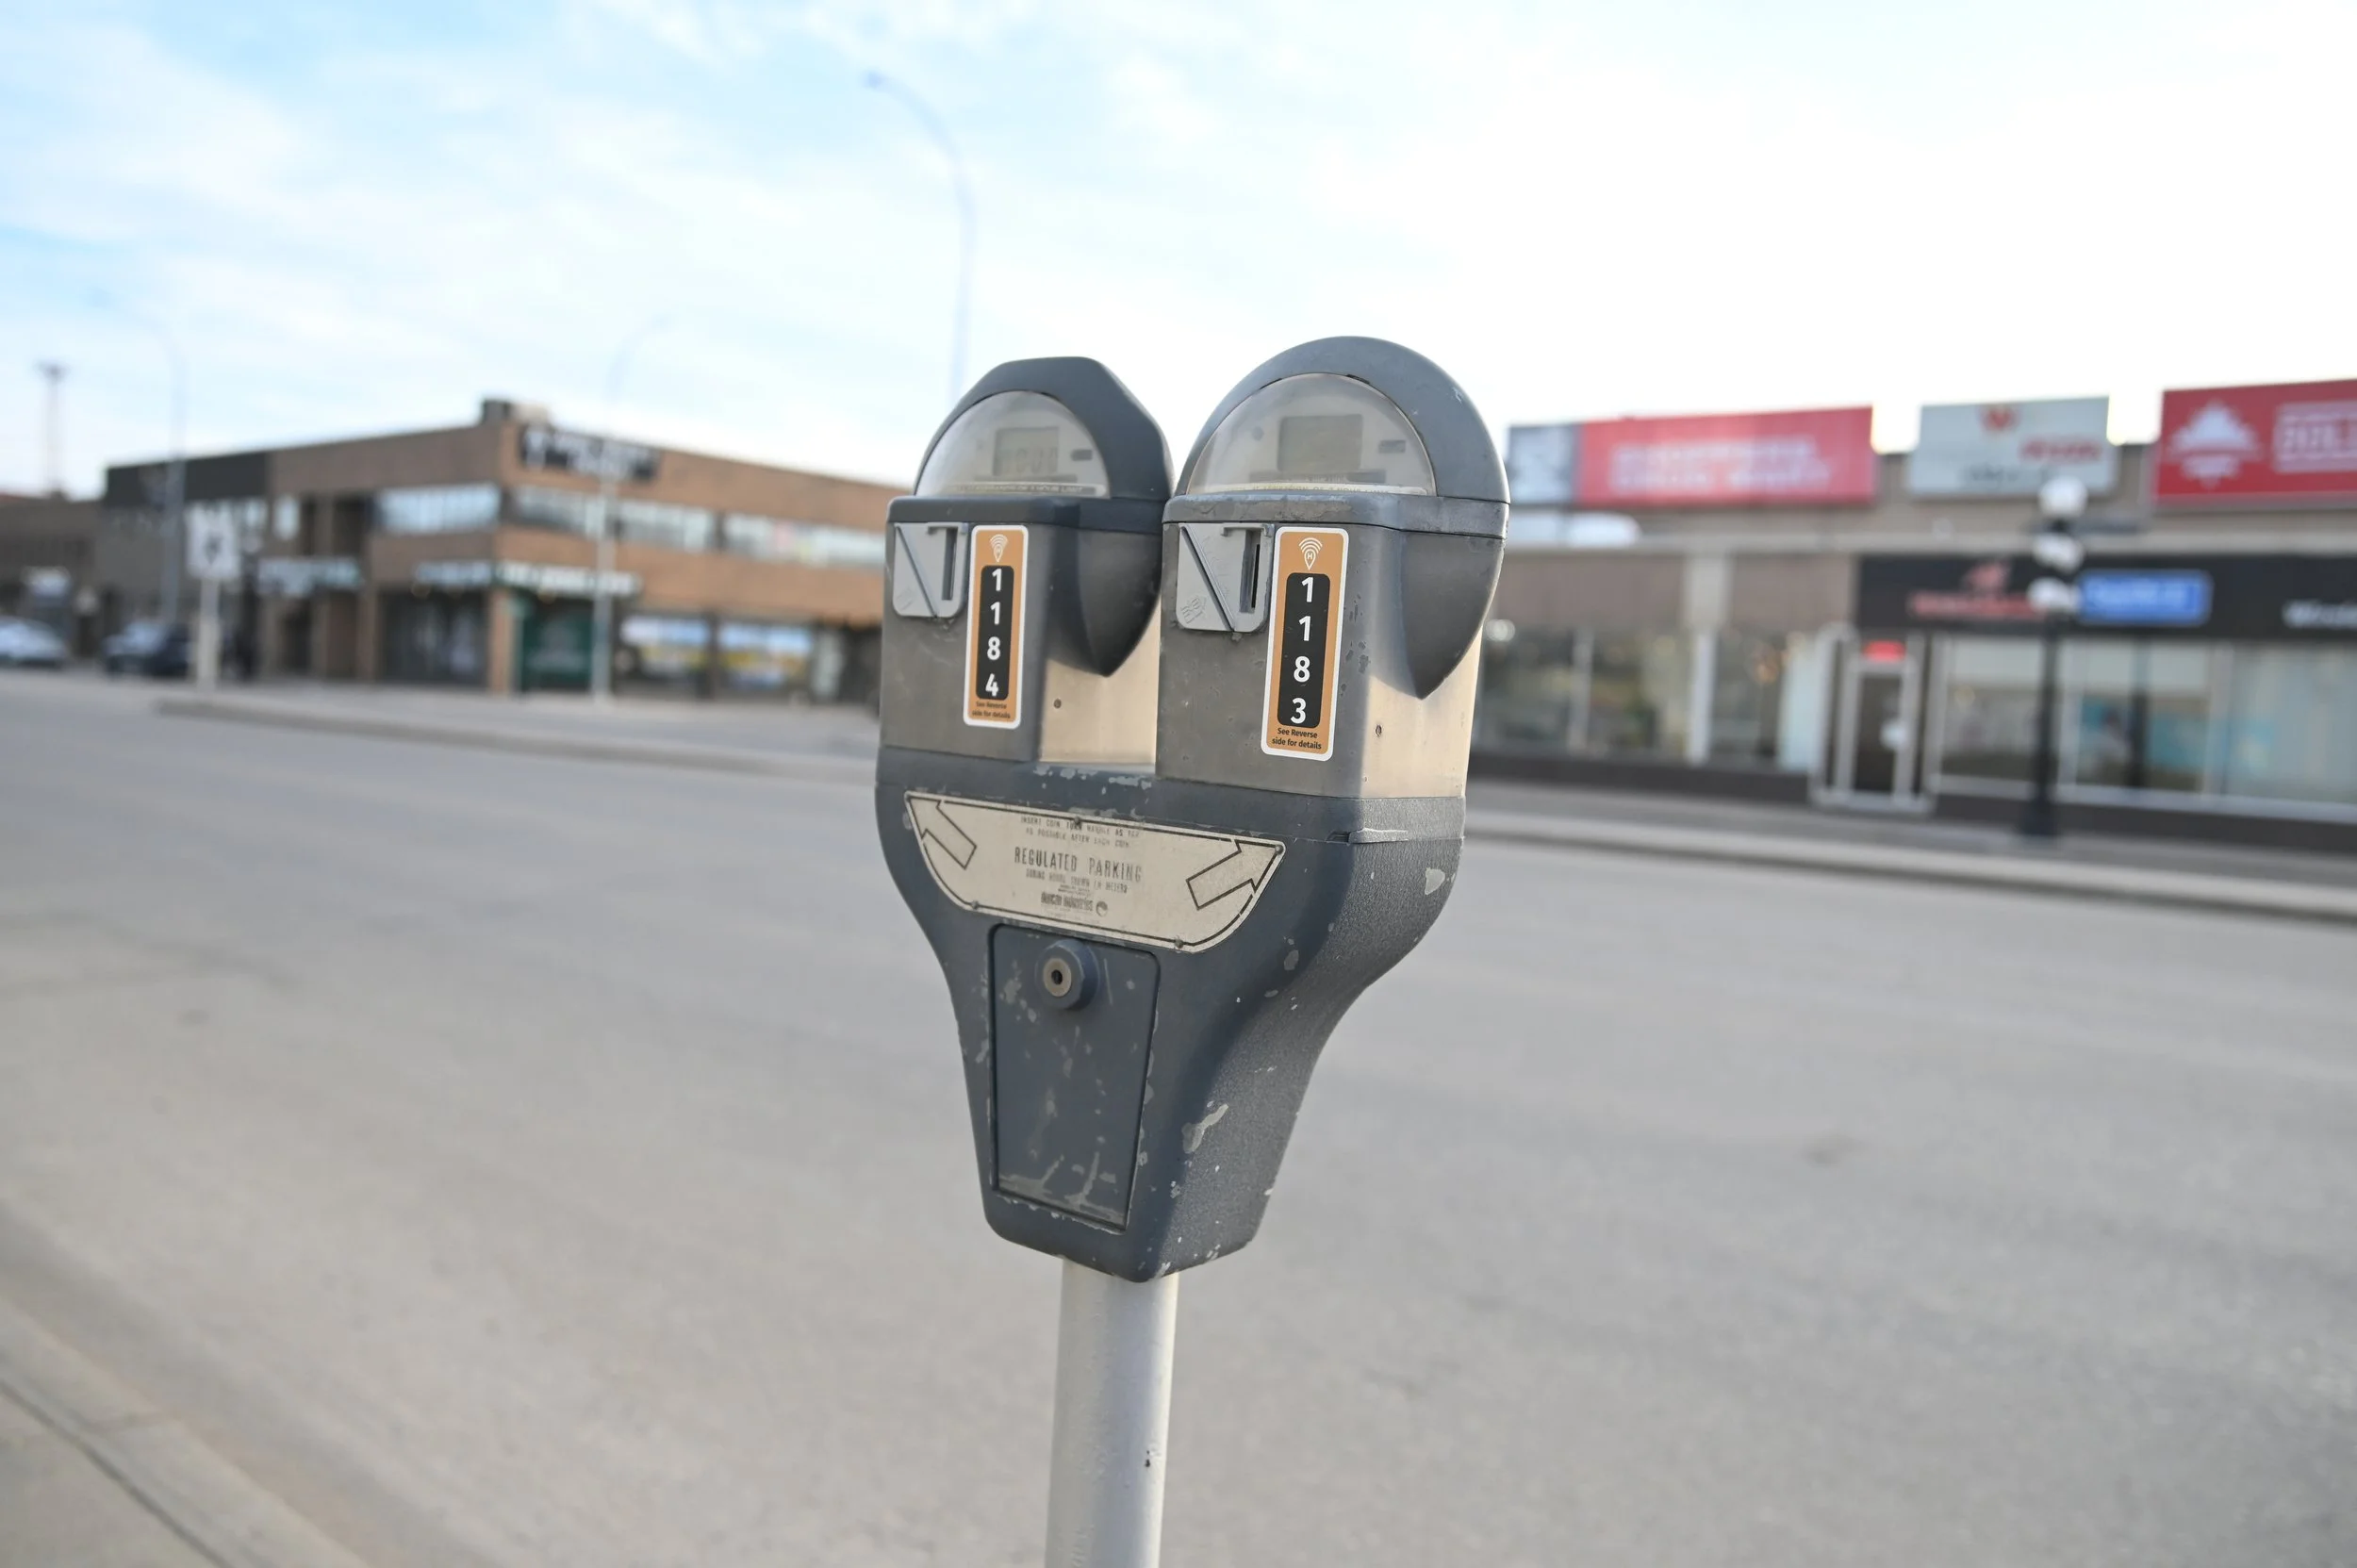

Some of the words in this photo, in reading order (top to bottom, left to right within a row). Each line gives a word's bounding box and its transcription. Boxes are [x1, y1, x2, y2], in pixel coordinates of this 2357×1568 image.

[985, 568, 1003, 697] 1184
[1290, 576, 1314, 724] 1183
[1272, 736, 1286, 745] side
[1287, 738, 1297, 747] for
[1298, 740, 1322, 750] details
[1277, 727, 1290, 735] See
[1291, 729, 1318, 738] Reverse
[1014, 846, 1078, 873] REGULATED
[1088, 856, 1142, 883] PARKING
